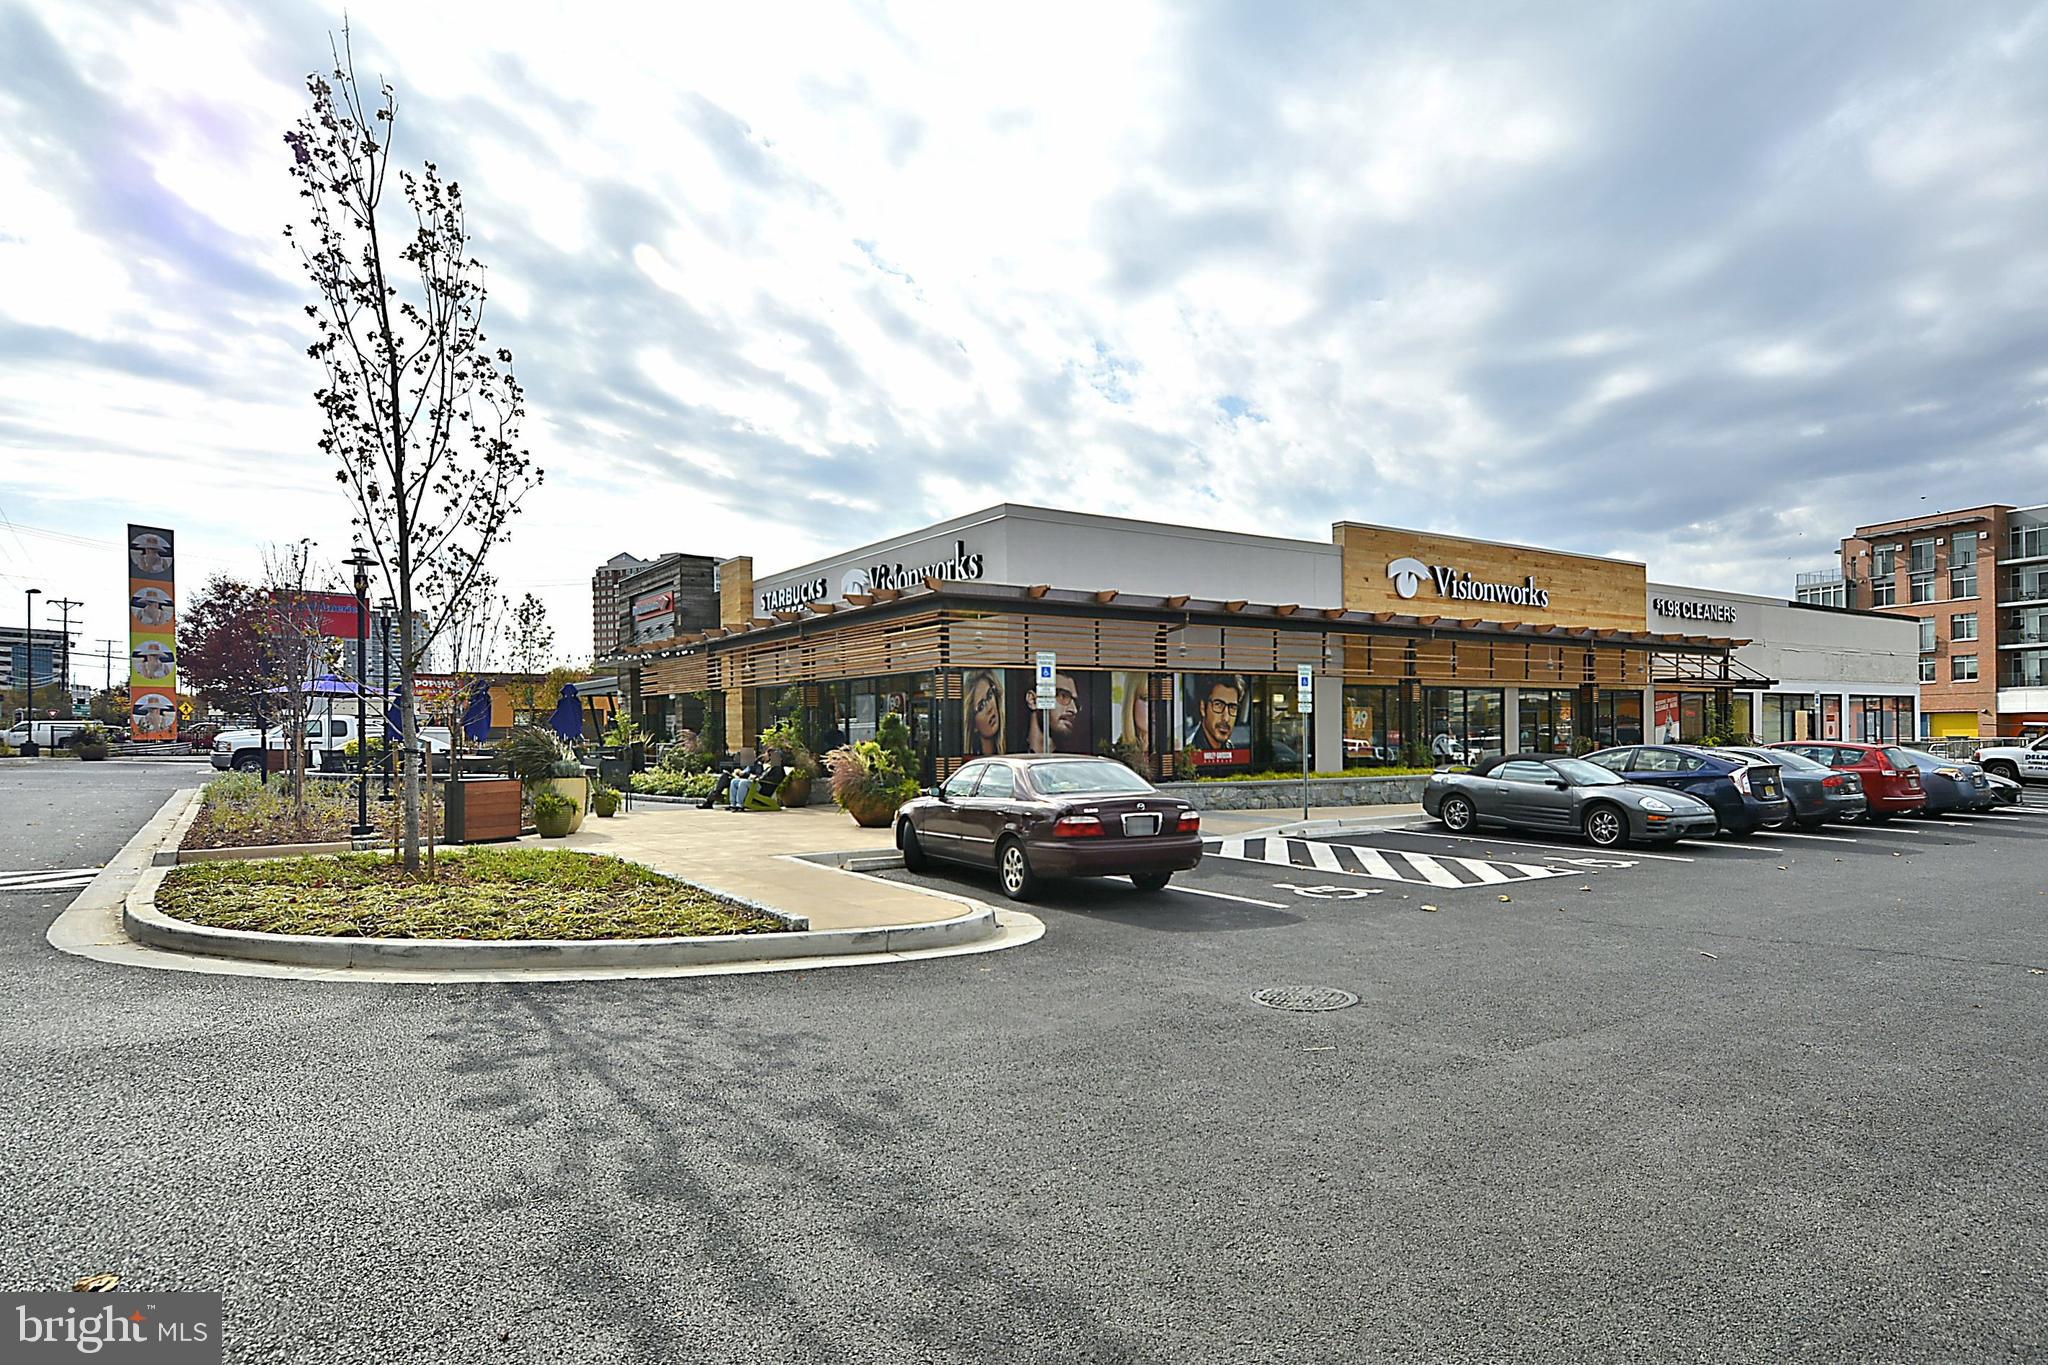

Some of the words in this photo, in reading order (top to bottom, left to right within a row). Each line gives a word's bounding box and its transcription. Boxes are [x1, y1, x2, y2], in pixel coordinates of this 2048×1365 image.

[868, 540, 982, 590] Visionworks
[760, 578, 825, 611] STARBUCKS
[1432, 565, 1549, 608] Visionworks
[1654, 599, 1681, 617] $1.98
[1682, 601, 1737, 623] CLEANERS
